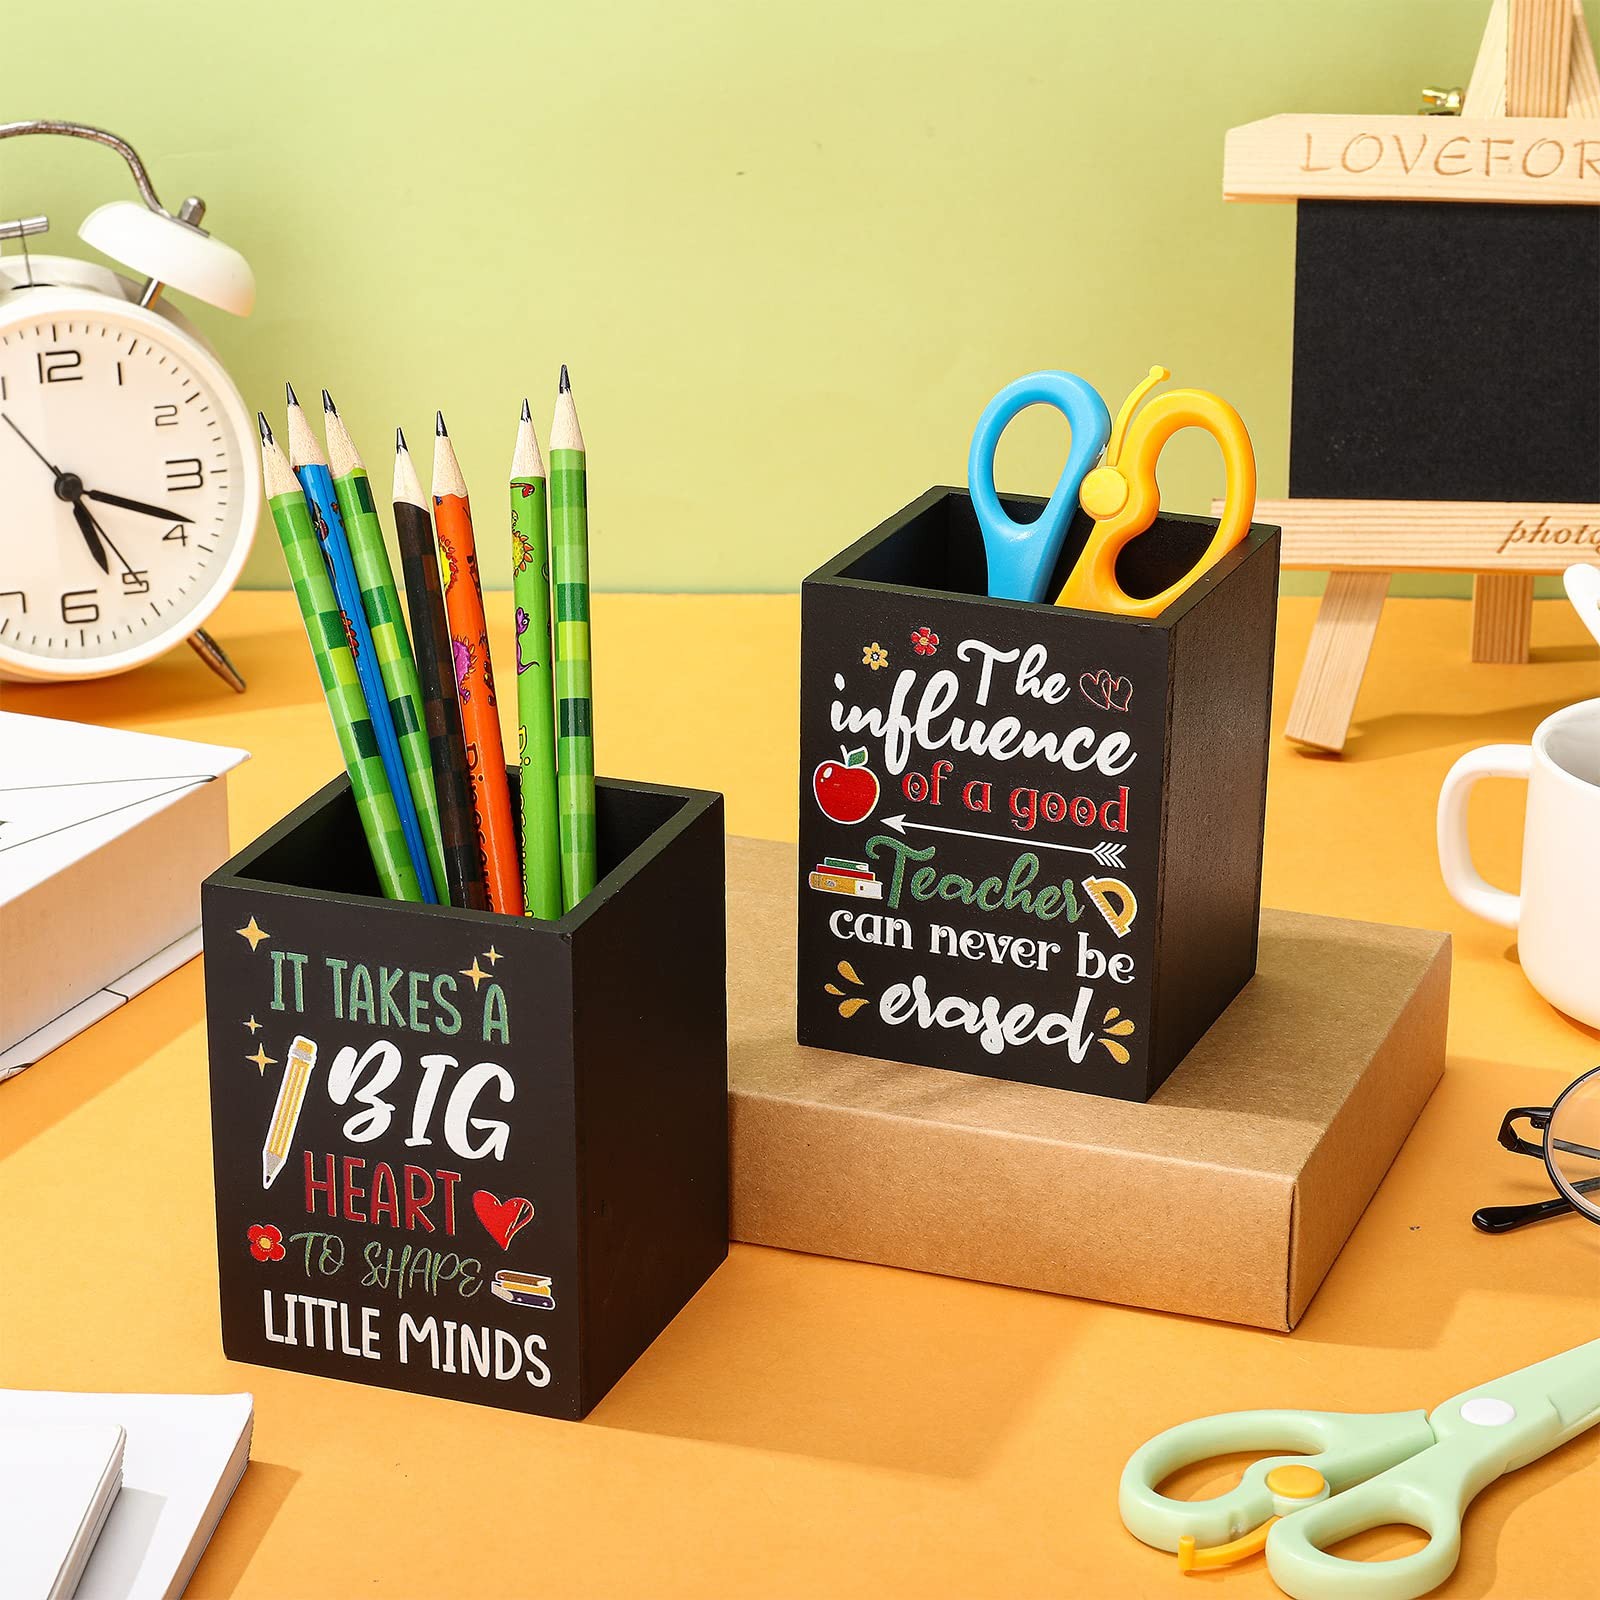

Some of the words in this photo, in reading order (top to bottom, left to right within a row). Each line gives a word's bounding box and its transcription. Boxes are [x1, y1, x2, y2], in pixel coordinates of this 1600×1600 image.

[1300, 132, 1600, 180] LOVEFOR
[36, 349, 84, 385] 12
[116, 361, 124, 387] 1
[153, 404, 179, 427] 2
[164, 457, 204, 492] 3
[161, 523, 189, 547] 4
[60, 588, 100, 625] 6
[121, 569, 150, 596] 5
[957, 638, 1071, 707] The
[829, 668, 1138, 777] influence
[901, 759, 954, 806] of
[962, 780, 993, 813] a
[1009, 785, 1129, 834] good
[864, 834, 1086, 924] Teacher
[829, 909, 914, 951] can
[929, 924, 1061, 972] never
[1076, 931, 1136, 985] be
[269, 950, 309, 1013] IT
[325, 957, 463, 1037] TAKES
[482, 982, 511, 1046] A
[878, 974, 1095, 1065] erased
[327, 1038, 516, 1162] BIG
[304, 1149, 462, 1237] HEART
[288, 1230, 346, 1278] TO
[360, 1240, 484, 1299] SHAPE
[263, 1289, 382, 1361] LITTLE
[398, 1312, 552, 1388] MINDS
